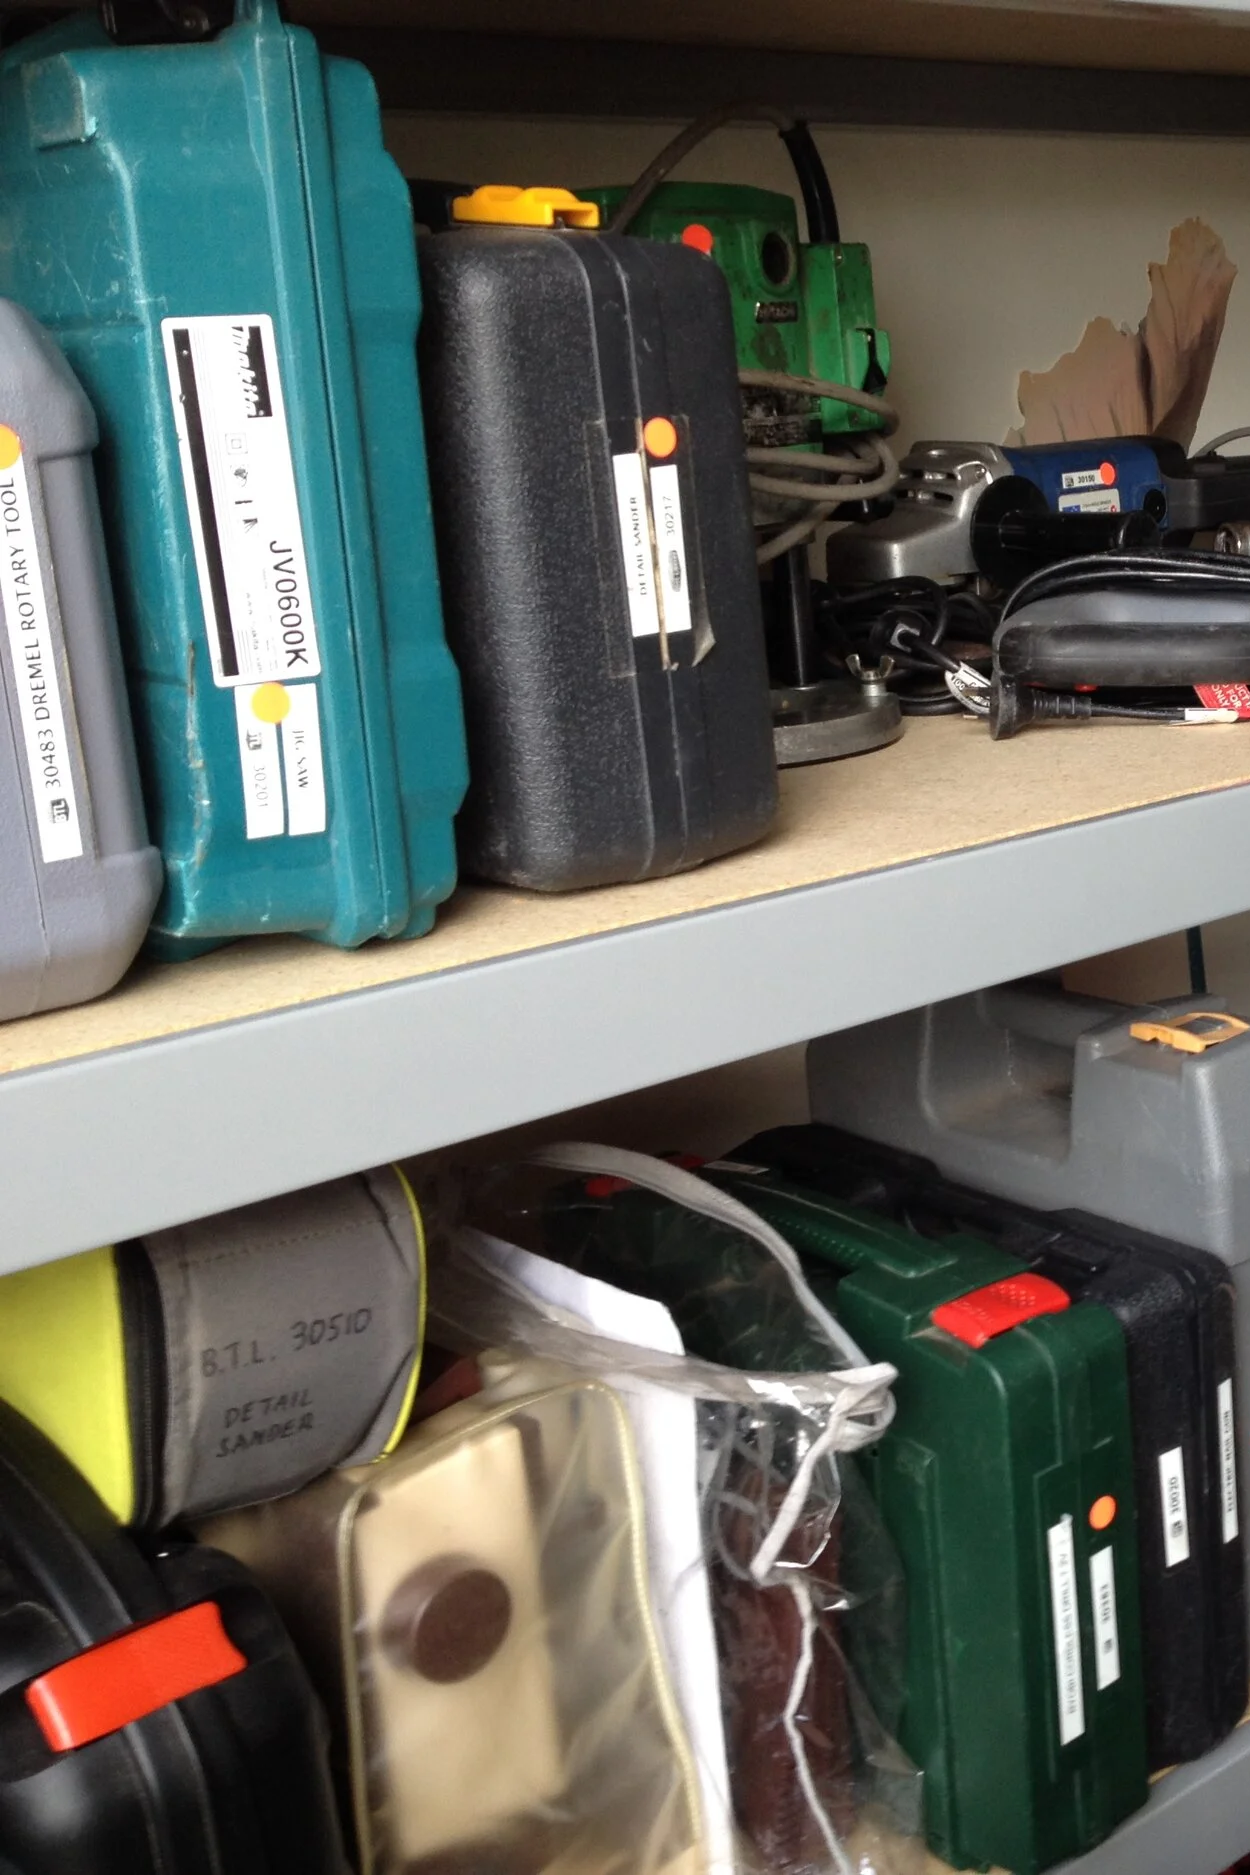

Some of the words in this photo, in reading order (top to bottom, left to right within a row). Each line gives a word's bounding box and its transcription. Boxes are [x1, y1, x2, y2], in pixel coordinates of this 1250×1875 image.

[1, 477, 21, 541] TOOL
[629, 497, 642, 547] SANDER
[662, 496, 675, 537] 30217
[9, 545, 37, 632] ROTARY
[636, 554, 648, 596] DETAIL
[269, 540, 309, 668] JV0600K
[25, 638, 51, 721] DREMEL
[45, 729, 62, 788] 30483
[253, 764, 268, 807] 30201
[291, 1308, 372, 1351] 30510
[225, 1389, 312, 1429] DETAIL
[216, 1412, 314, 1457] SANDER
